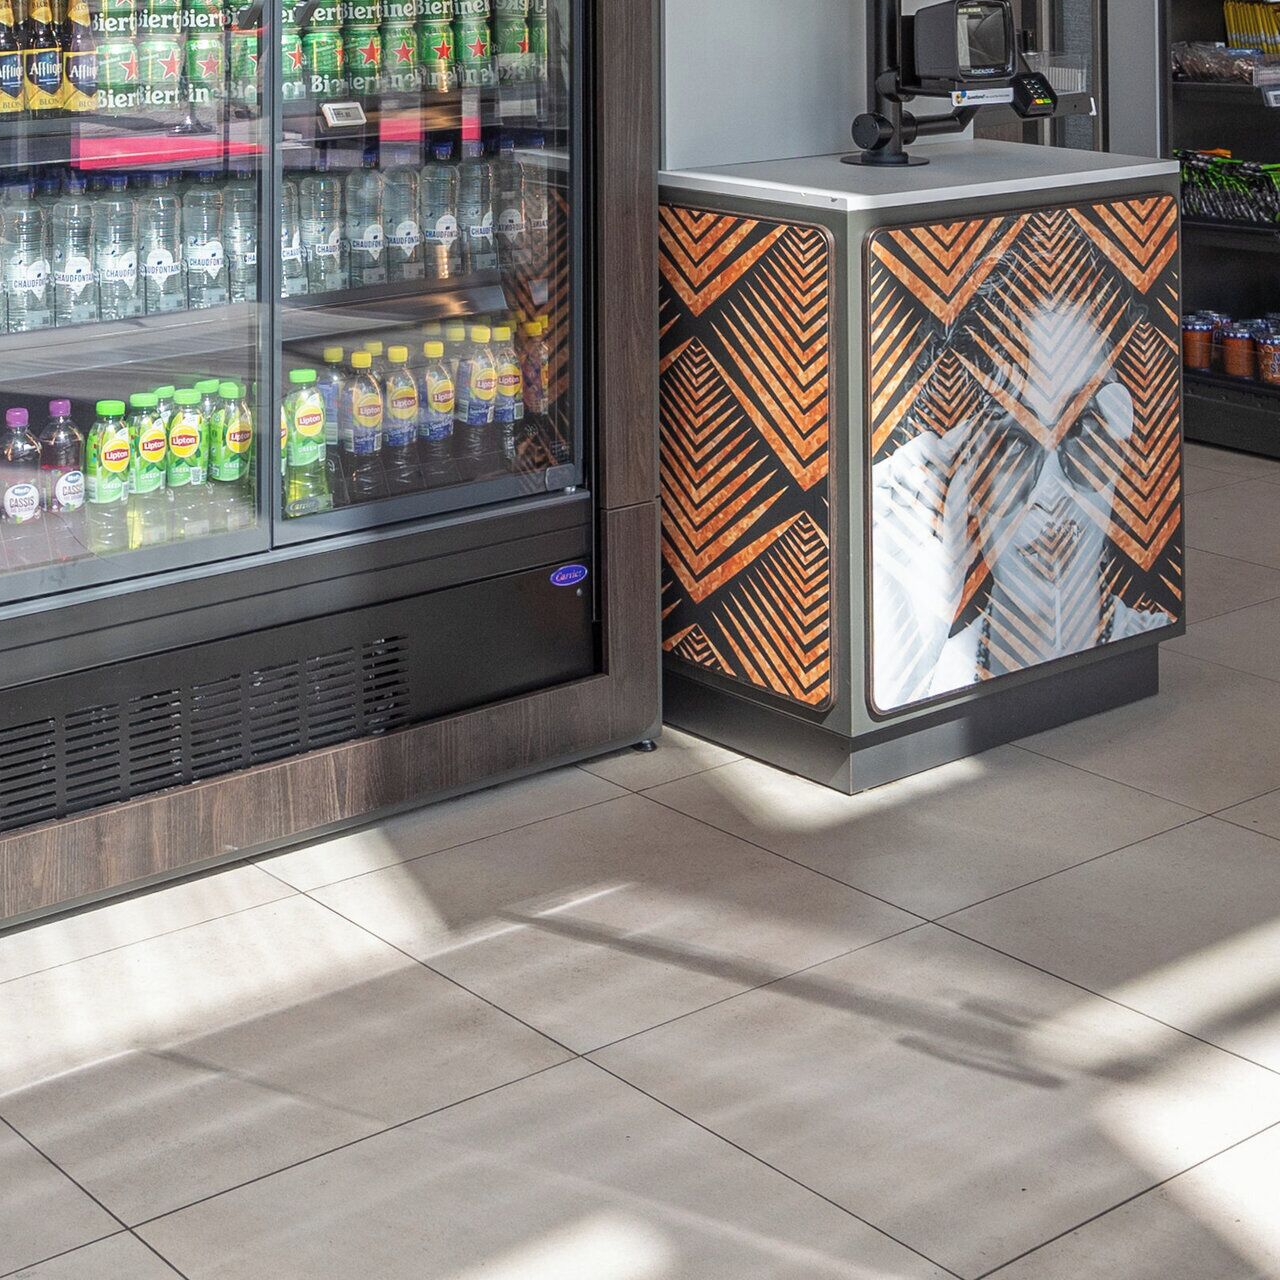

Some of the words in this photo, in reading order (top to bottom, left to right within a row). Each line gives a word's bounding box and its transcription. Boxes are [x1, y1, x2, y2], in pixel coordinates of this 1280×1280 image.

[299, 414, 321, 425] Lipton
[172, 435, 196, 445] Lipton
[230, 432, 250, 442] Lipton
[143, 440, 165, 451] Lipton
[106, 450, 128, 461] Lipton
